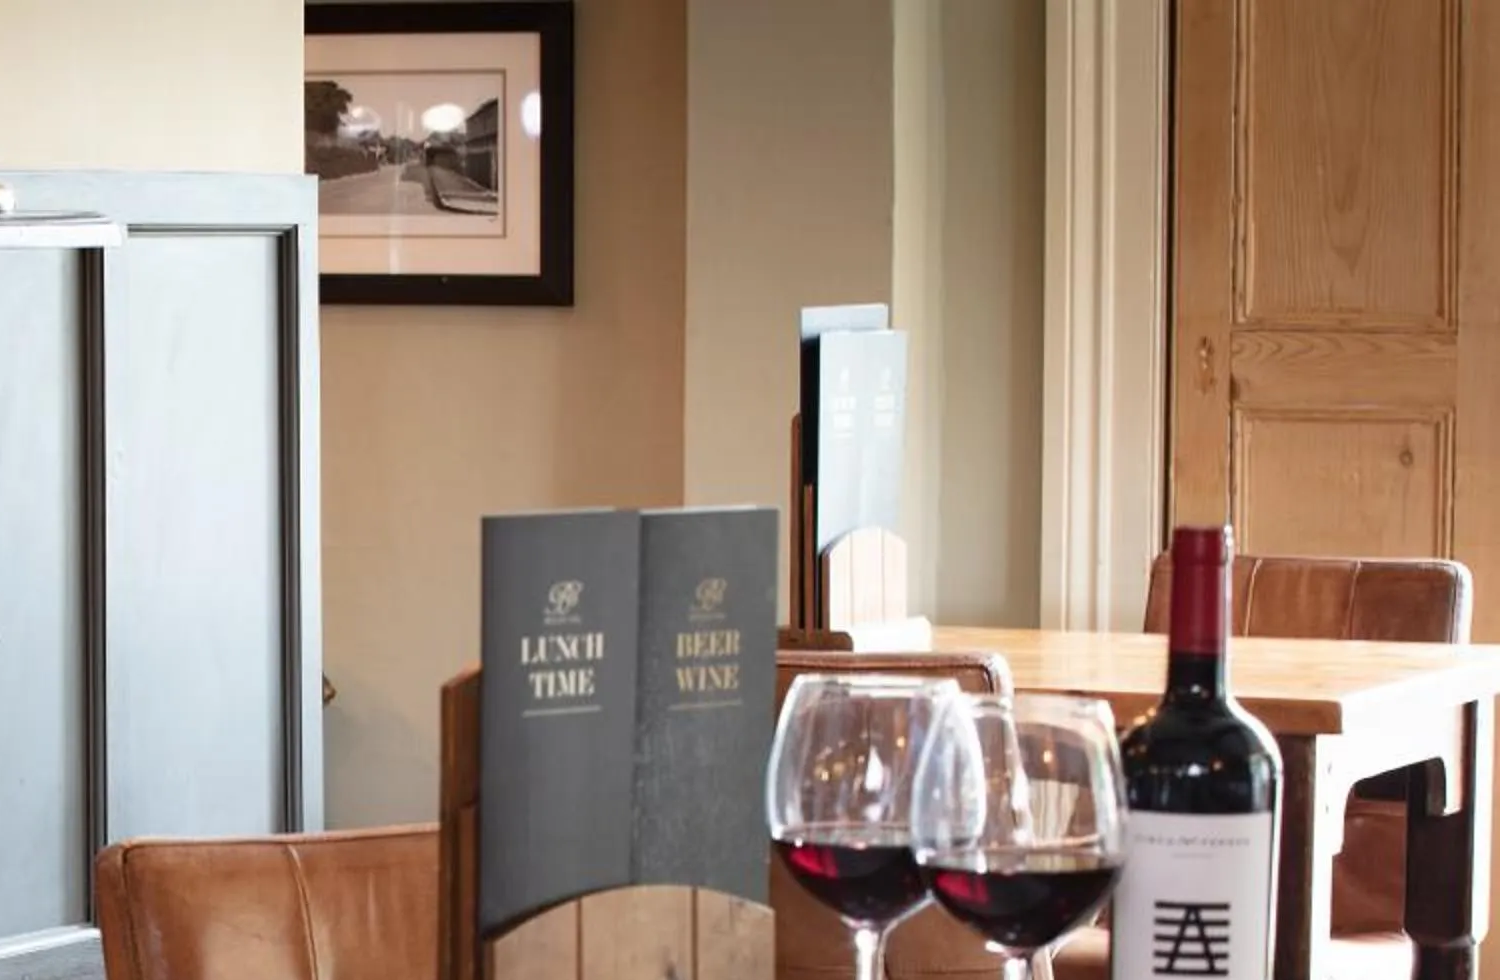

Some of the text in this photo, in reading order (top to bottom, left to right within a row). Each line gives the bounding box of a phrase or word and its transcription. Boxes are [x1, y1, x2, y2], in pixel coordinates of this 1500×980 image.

[521, 632, 603, 665] LUNCH
[677, 629, 740, 658] BEER
[529, 667, 594, 698] TIME
[676, 664, 739, 691] WINE
